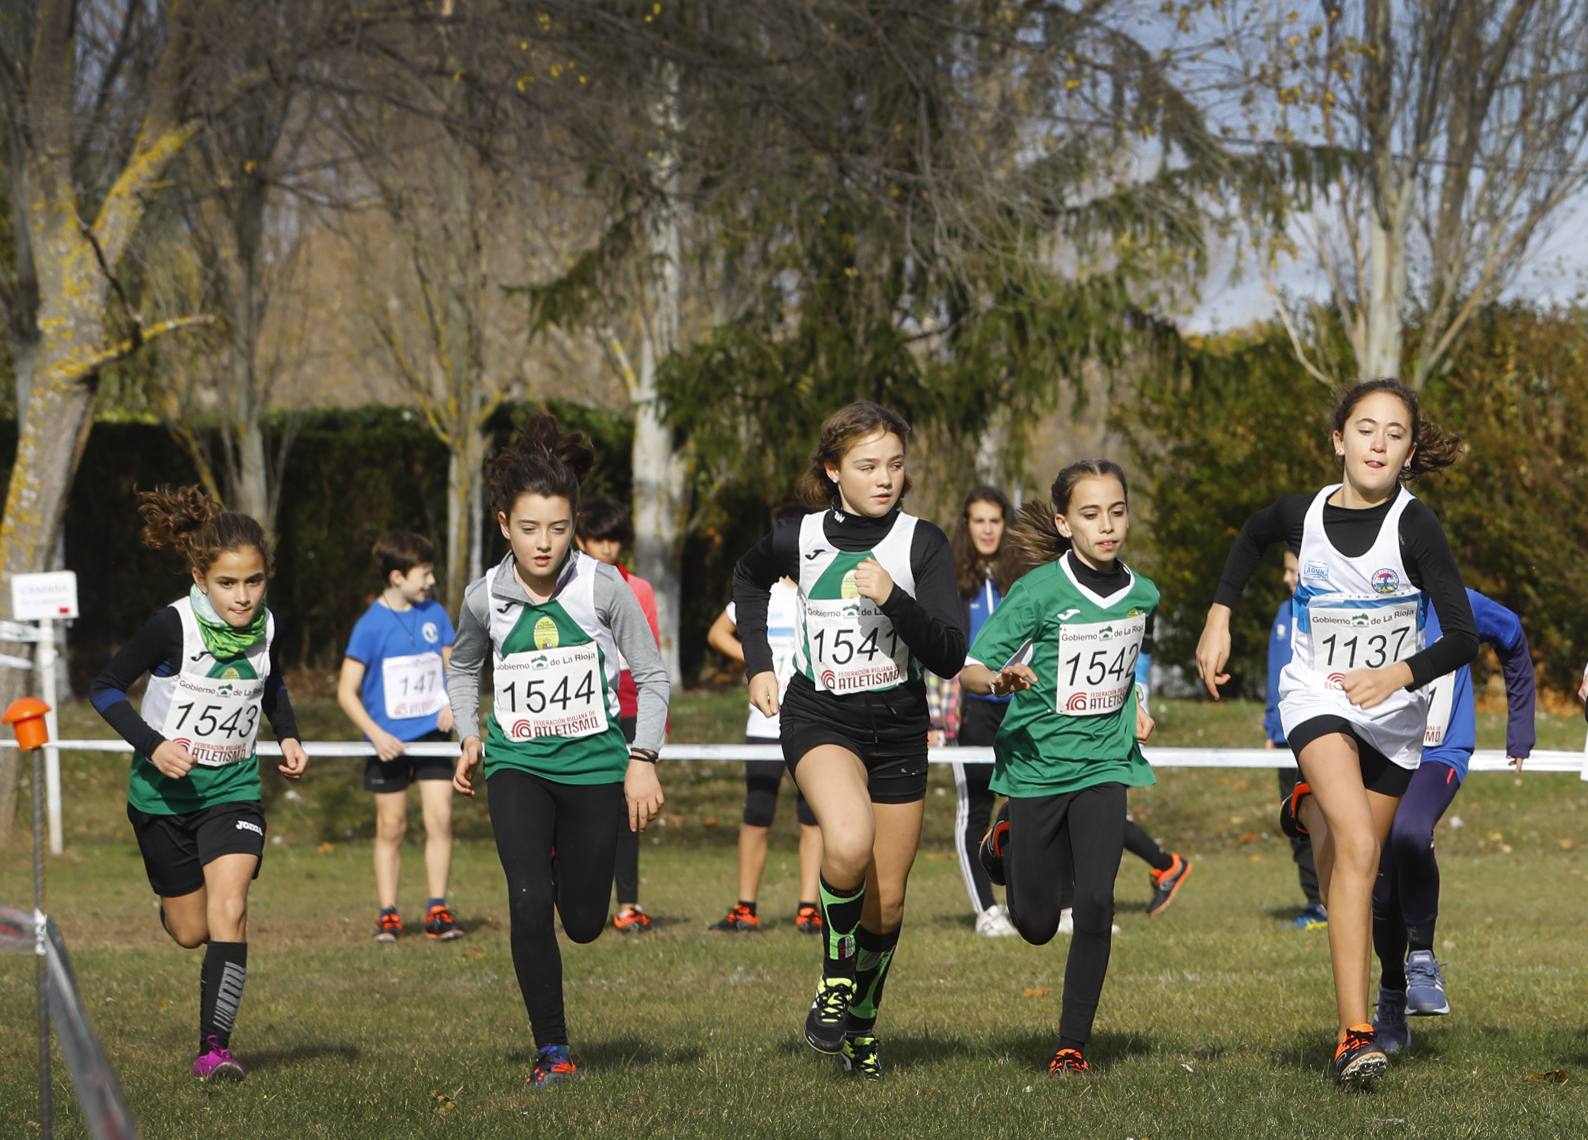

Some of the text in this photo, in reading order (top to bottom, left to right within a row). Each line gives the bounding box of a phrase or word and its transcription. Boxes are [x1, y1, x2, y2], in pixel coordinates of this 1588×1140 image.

[807, 607, 841, 617] Gobierno
[861, 608, 873, 616] de
[1312, 615, 1351, 625] Gobierno
[1383, 614, 1393, 622] La
[1394, 608, 1414, 619] Rioja
[1061, 632, 1098, 642] Gobierno
[1114, 629, 1123, 637] de
[1124, 627, 1132, 636] La
[814, 627, 898, 665] 1541
[1322, 626, 1410, 669] 1137
[550, 658, 560, 667] de
[563, 656, 573, 664] La
[574, 653, 596, 662] Rioja
[1065, 643, 1139, 687] 1542
[180, 680, 216, 695] Gobierno
[400, 670, 437, 696] 147
[839, 669, 900, 690] ATLETISMO
[503, 669, 596, 714] 1544
[176, 701, 259, 739] 1543
[535, 716, 600, 737] ATLETISMO
[192, 747, 247, 762] ATLETISMO
